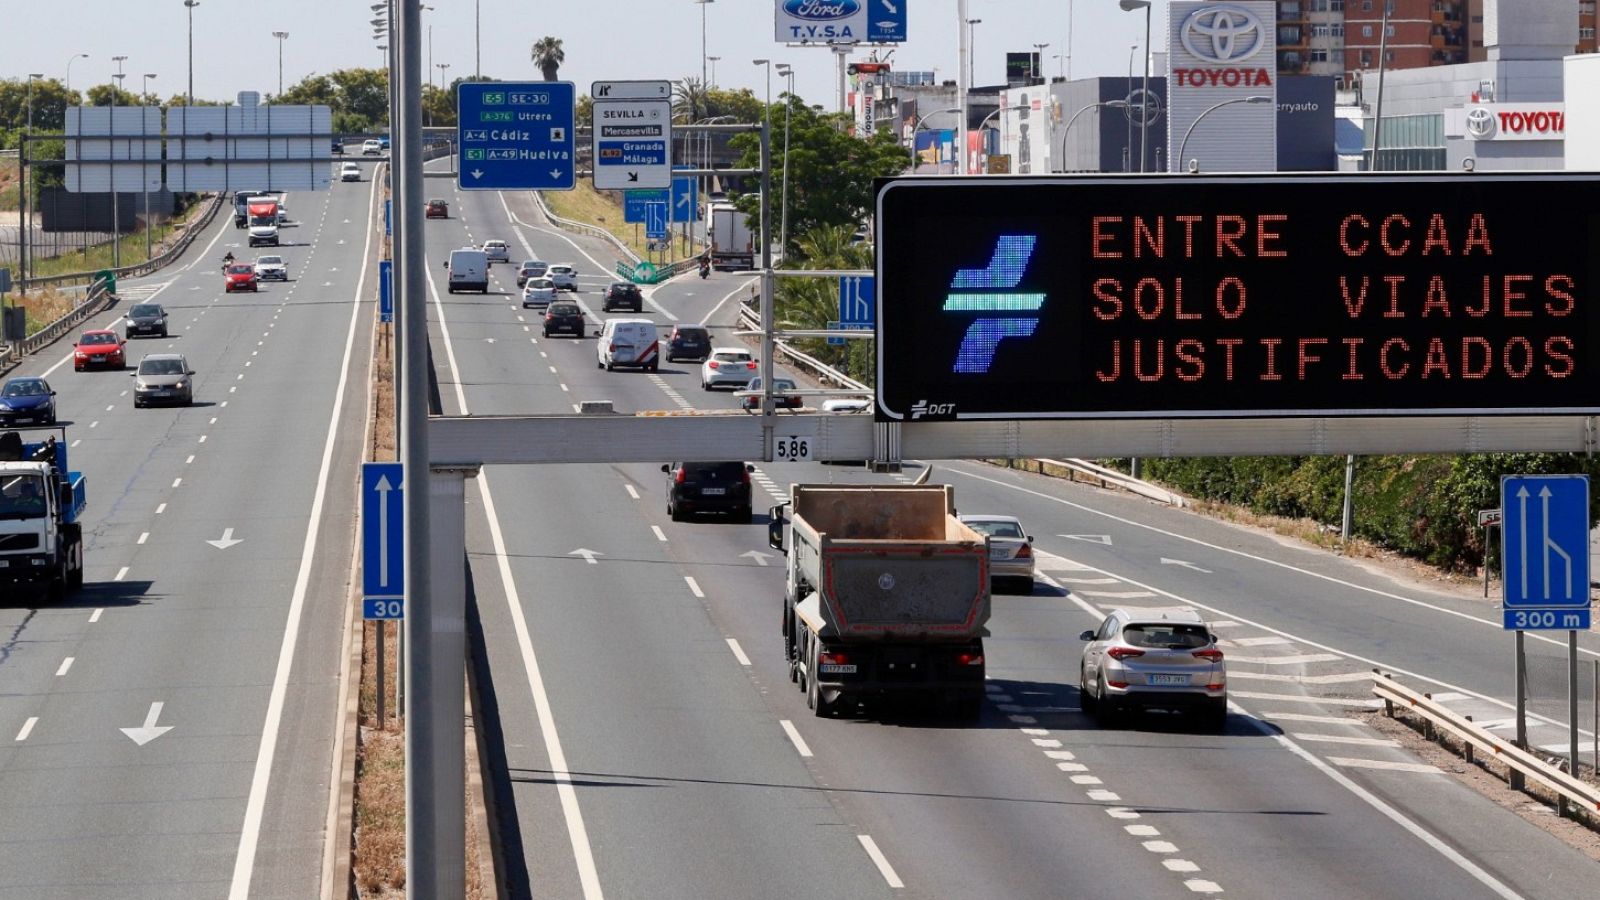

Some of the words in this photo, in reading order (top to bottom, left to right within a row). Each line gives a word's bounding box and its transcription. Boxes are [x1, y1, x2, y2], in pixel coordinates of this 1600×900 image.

[798, 0, 846, 16] Ford
[1172, 68, 1272, 88] TOYOTA
[660, 86, 665, 94] 2
[485, 95, 502, 103] E-5
[511, 95, 548, 103] SE-30
[518, 112, 552, 121] Utrera
[603, 110, 645, 119] SEVILLA
[466, 132, 486, 140] A-4
[491, 129, 530, 141] Cádiz
[604, 127, 660, 136] Mercasevilla
[623, 142, 664, 151] Granada
[489, 151, 516, 159] A-49
[519, 149, 569, 160] Huelva
[623, 154, 658, 164] Málaga
[1093, 214, 1288, 258] ENTRE
[1339, 213, 1493, 257] CCAA
[1093, 277, 1247, 320] SOLO
[1339, 274, 1575, 318] VIAJES
[1095, 336, 1575, 382] JUSTIFICADOS
[928, 403, 956, 415] DGT
[778, 440, 808, 459] 5,86
[1515, 611, 1555, 627] 300
[1563, 614, 1580, 627] m
